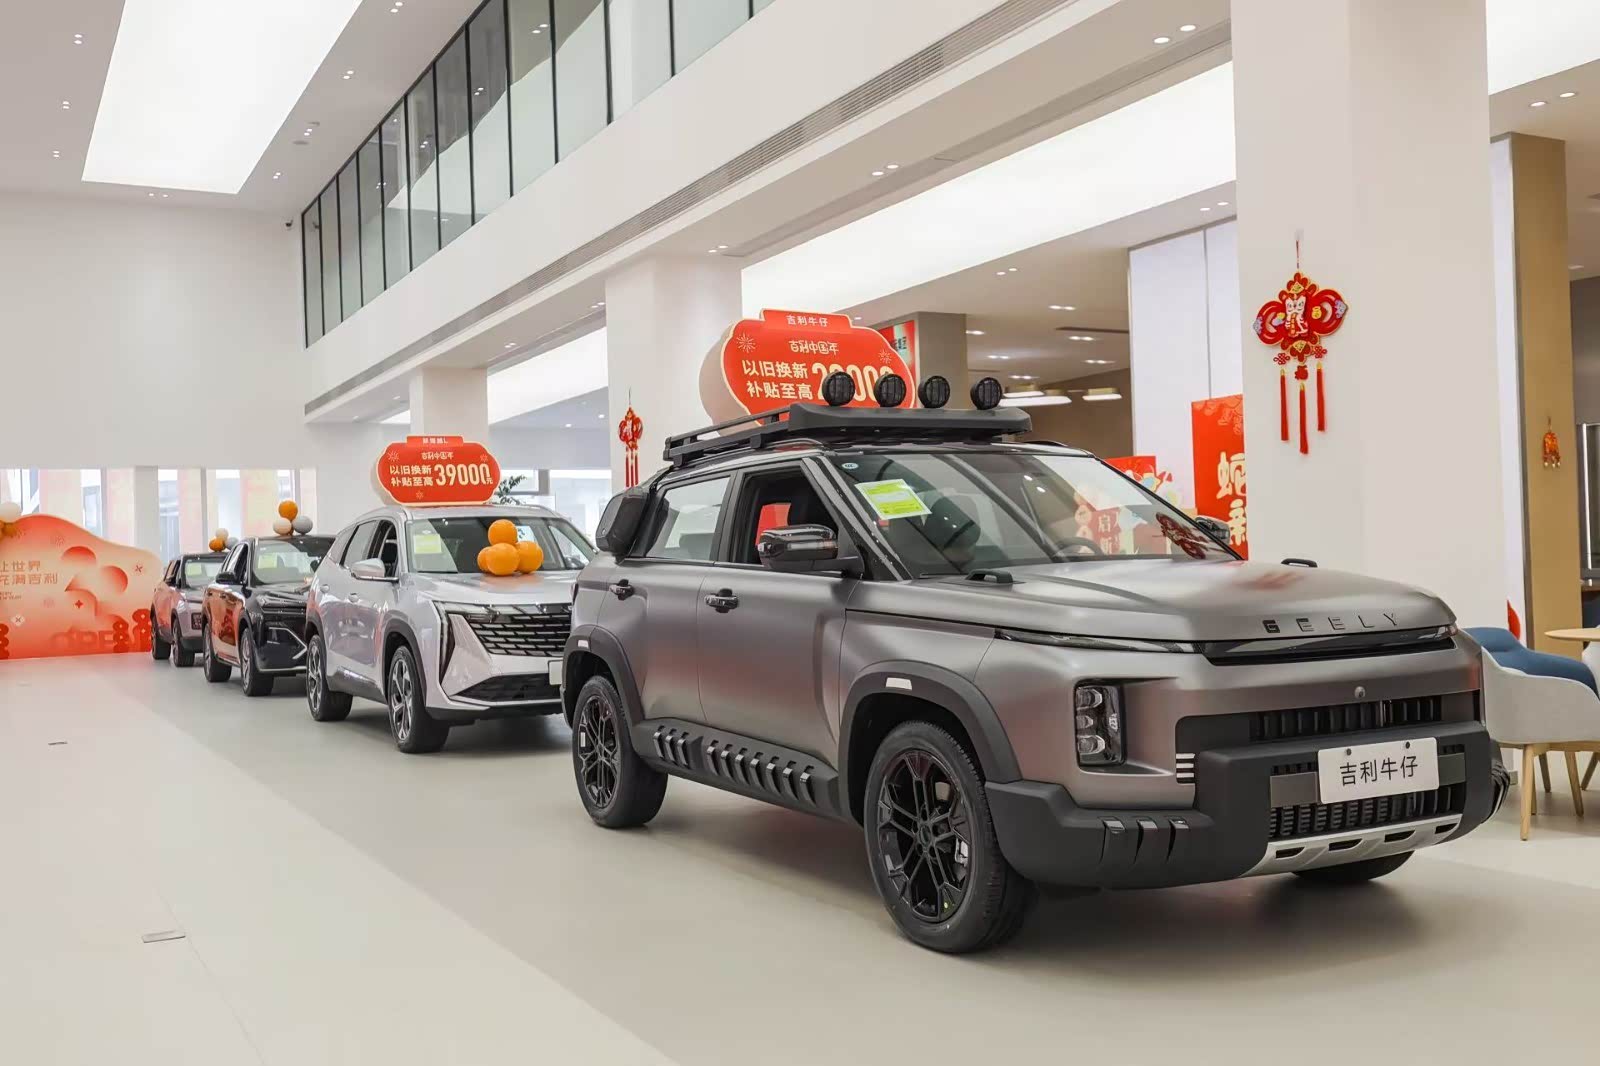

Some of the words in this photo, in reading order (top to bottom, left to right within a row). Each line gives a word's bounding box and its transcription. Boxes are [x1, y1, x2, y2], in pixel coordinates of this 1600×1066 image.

[786, 315, 828, 326] 吉利牛仔
[742, 359, 808, 378] 以旧换新
[747, 381, 812, 399] 补贴至高
[389, 465, 432, 475] 以旧换新
[391, 476, 434, 486] 补贴至高
[1262, 613, 1398, 634] GEELY
[1339, 755, 1419, 786] 吉利牛仔
